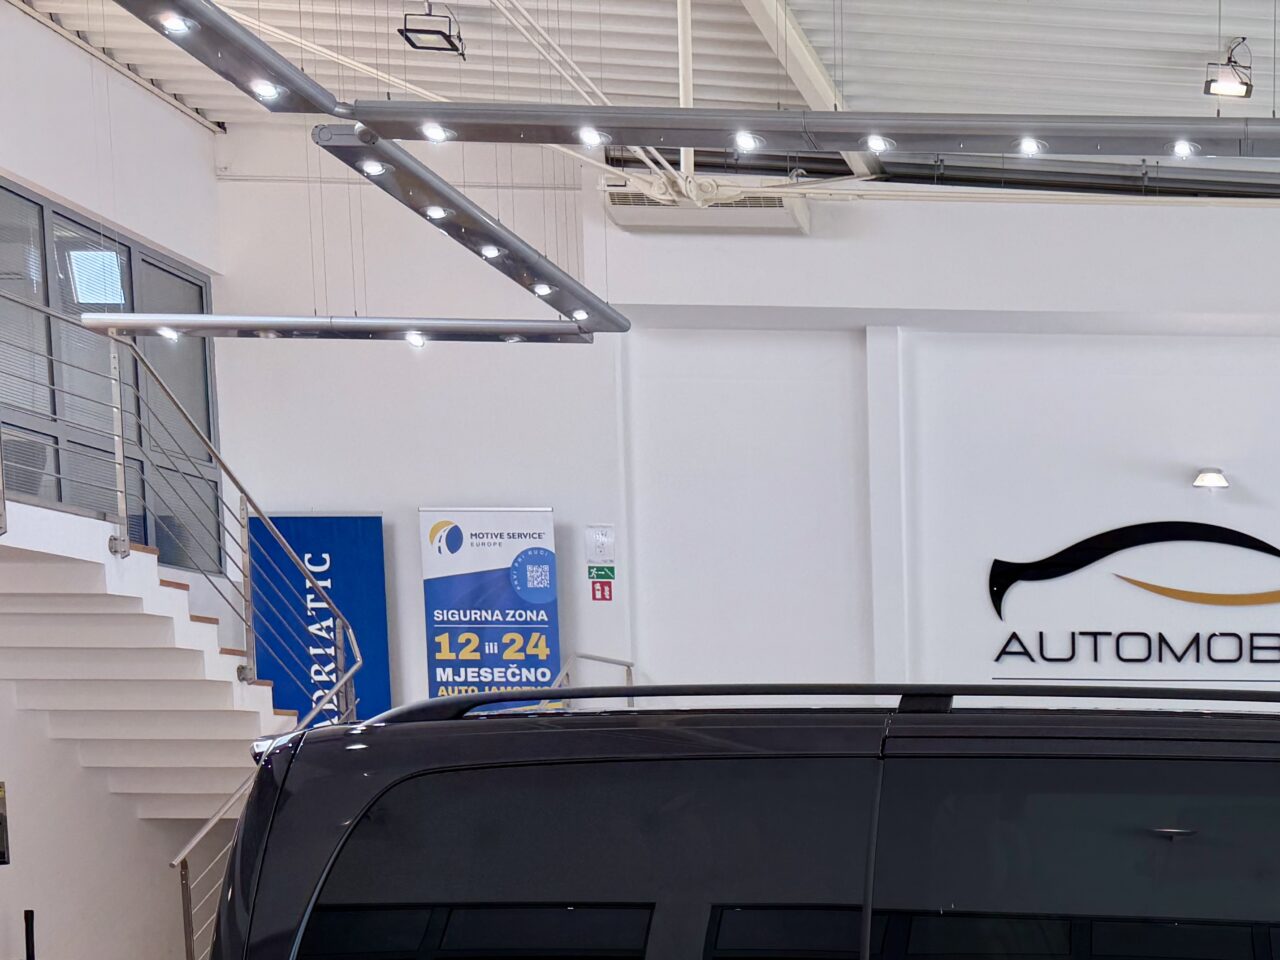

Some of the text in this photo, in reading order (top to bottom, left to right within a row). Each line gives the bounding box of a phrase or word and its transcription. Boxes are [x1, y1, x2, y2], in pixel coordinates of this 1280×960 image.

[470, 532, 505, 540] MOTIVE
[433, 610, 548, 621] SIGURNA ZONA
[434, 632, 551, 660] 12 ili 24
[435, 664, 552, 682] MJESEČNO
[437, 686, 479, 697] AUTO
